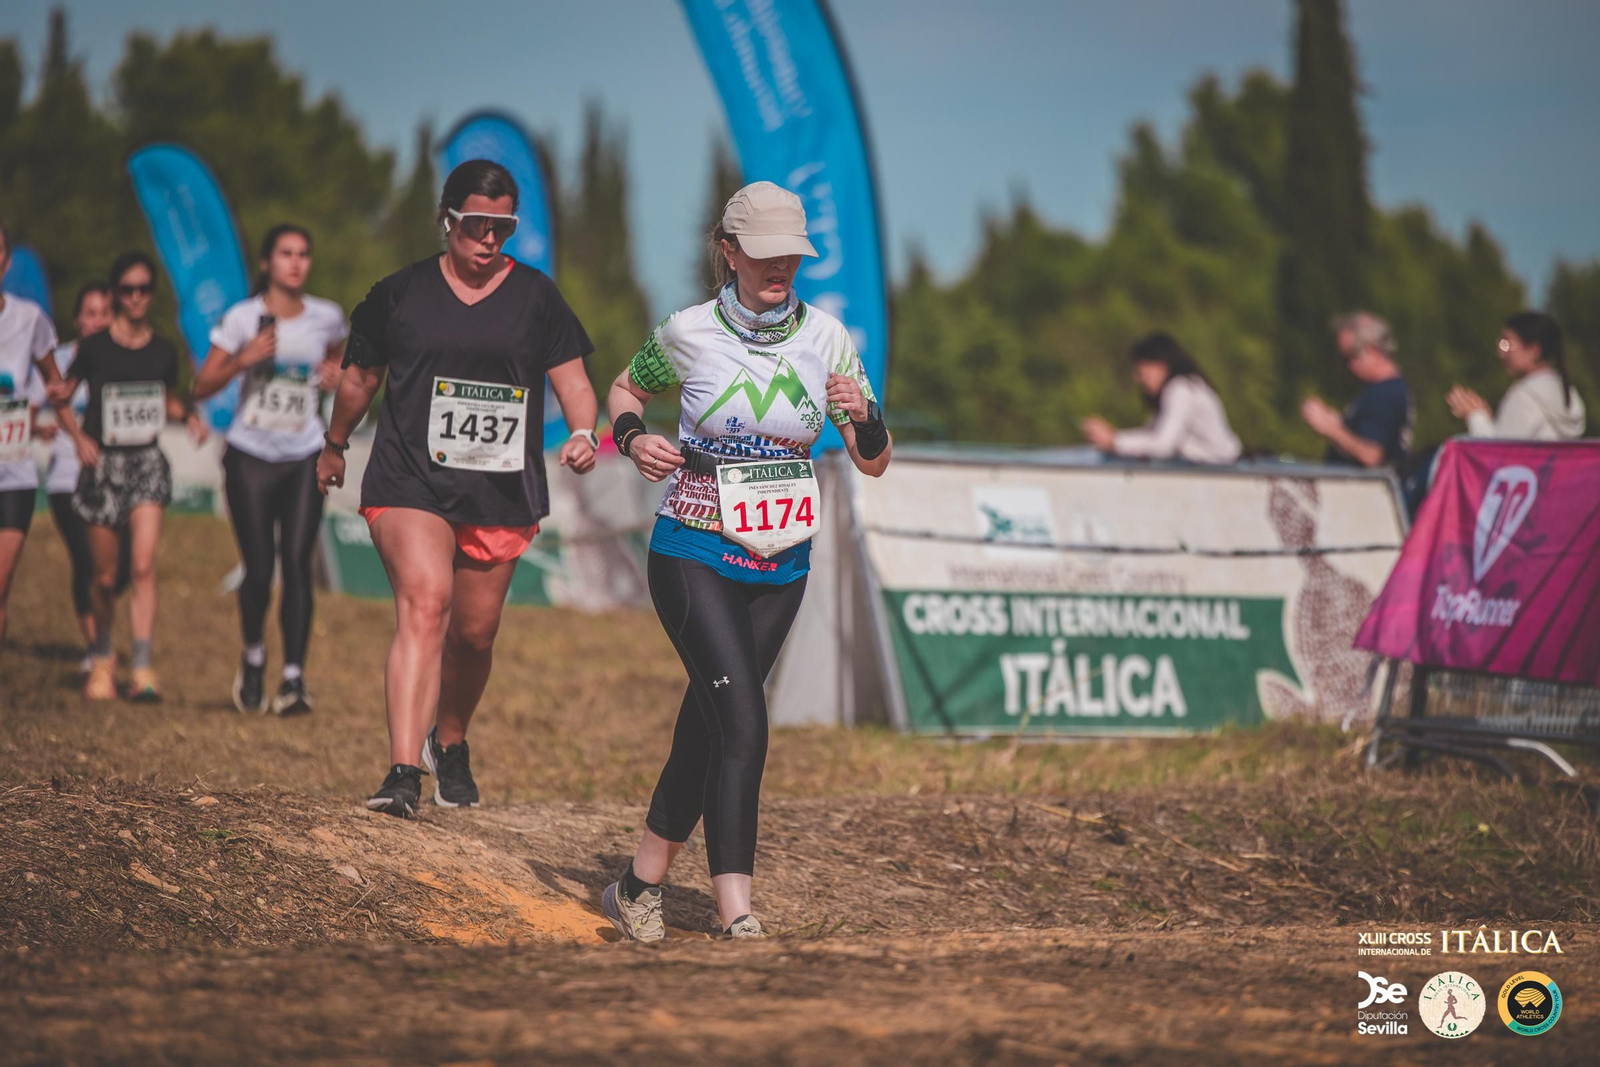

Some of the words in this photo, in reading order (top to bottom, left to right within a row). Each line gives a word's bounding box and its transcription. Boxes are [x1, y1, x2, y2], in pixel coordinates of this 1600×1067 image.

[461, 385, 504, 400] ITÁLICA
[0, 421, 25, 444] 77
[440, 411, 519, 445] 1437
[800, 411, 822, 421] 2020
[749, 465, 794, 479] ITÁLICA
[733, 496, 814, 533] 1174
[902, 593, 1009, 636] CROSS
[1010, 594, 1251, 640] INTERNACIONAL
[1431, 584, 1521, 631] TopRunner
[999, 637, 1188, 718] ITÁLICA
